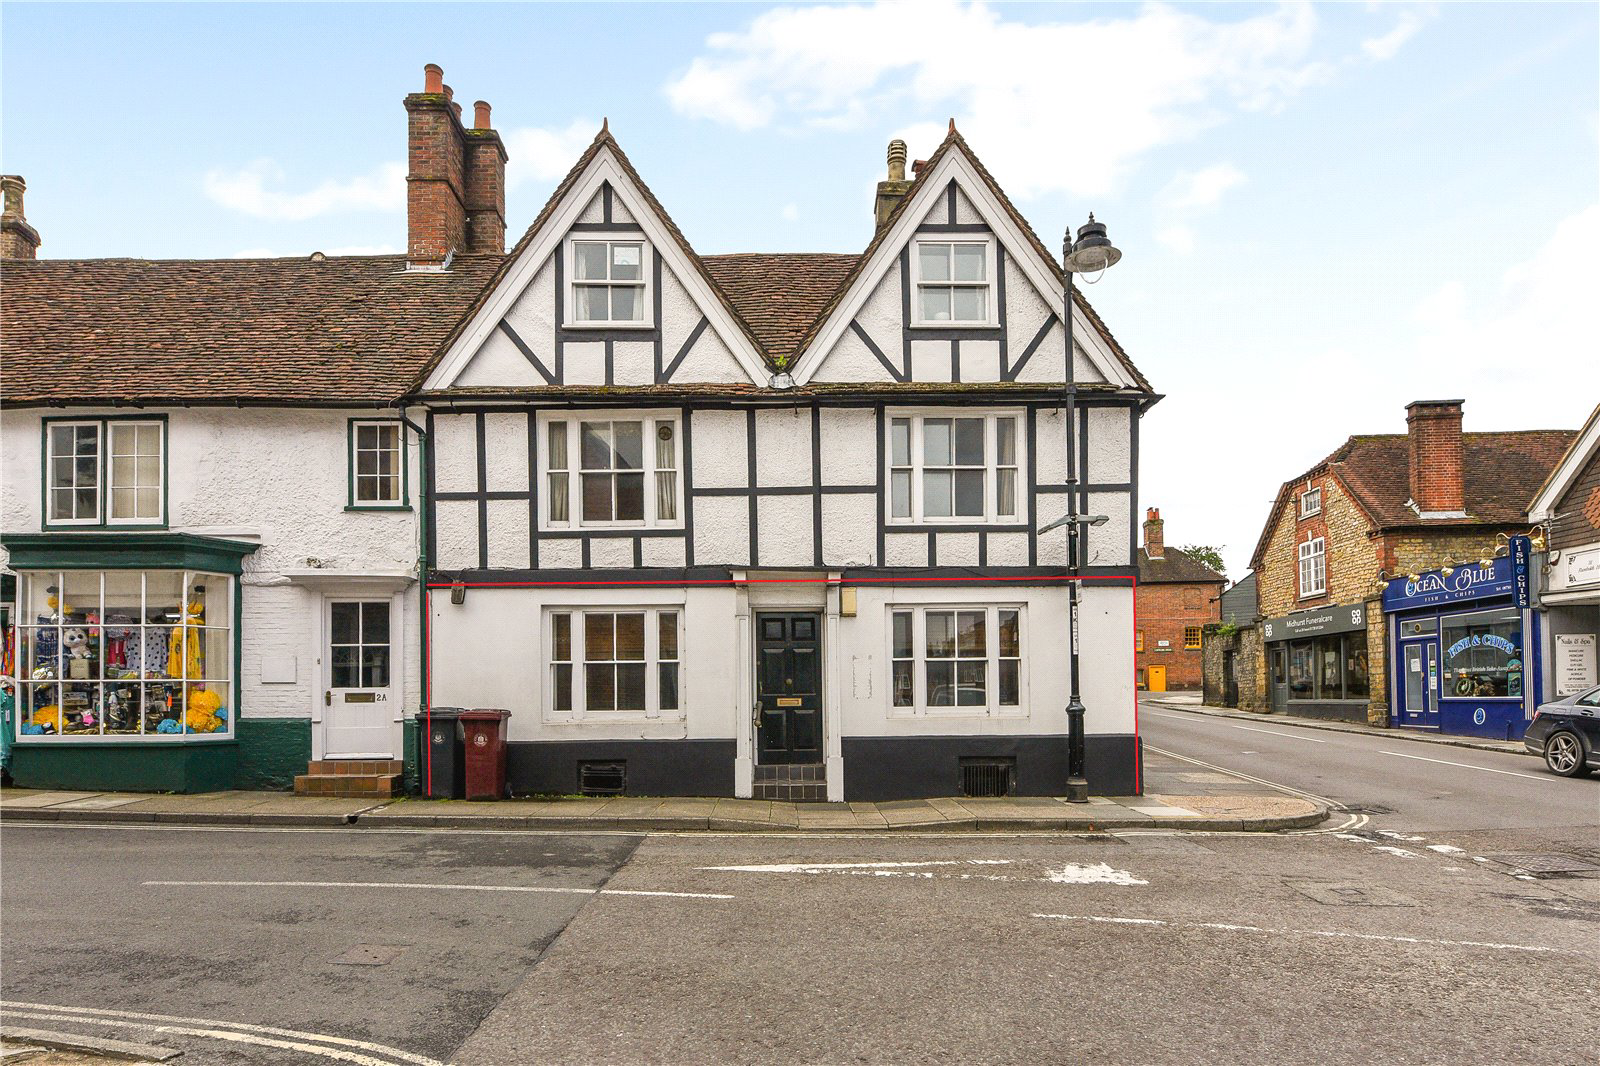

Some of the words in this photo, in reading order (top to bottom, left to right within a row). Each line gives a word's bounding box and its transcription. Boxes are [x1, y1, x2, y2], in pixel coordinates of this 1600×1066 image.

[1515, 539, 1524, 564] FISH
[1516, 565, 1525, 574] &
[1517, 575, 1527, 606] CHIPS
[1286, 619, 1306, 628] Midhurst
[1305, 615, 1333, 625] Funeralcare
[1447, 636, 1471, 658] FISH
[1471, 634, 1481, 646] &
[1481, 633, 1515, 655] CHIPS
[376, 693, 387, 701] 2A
